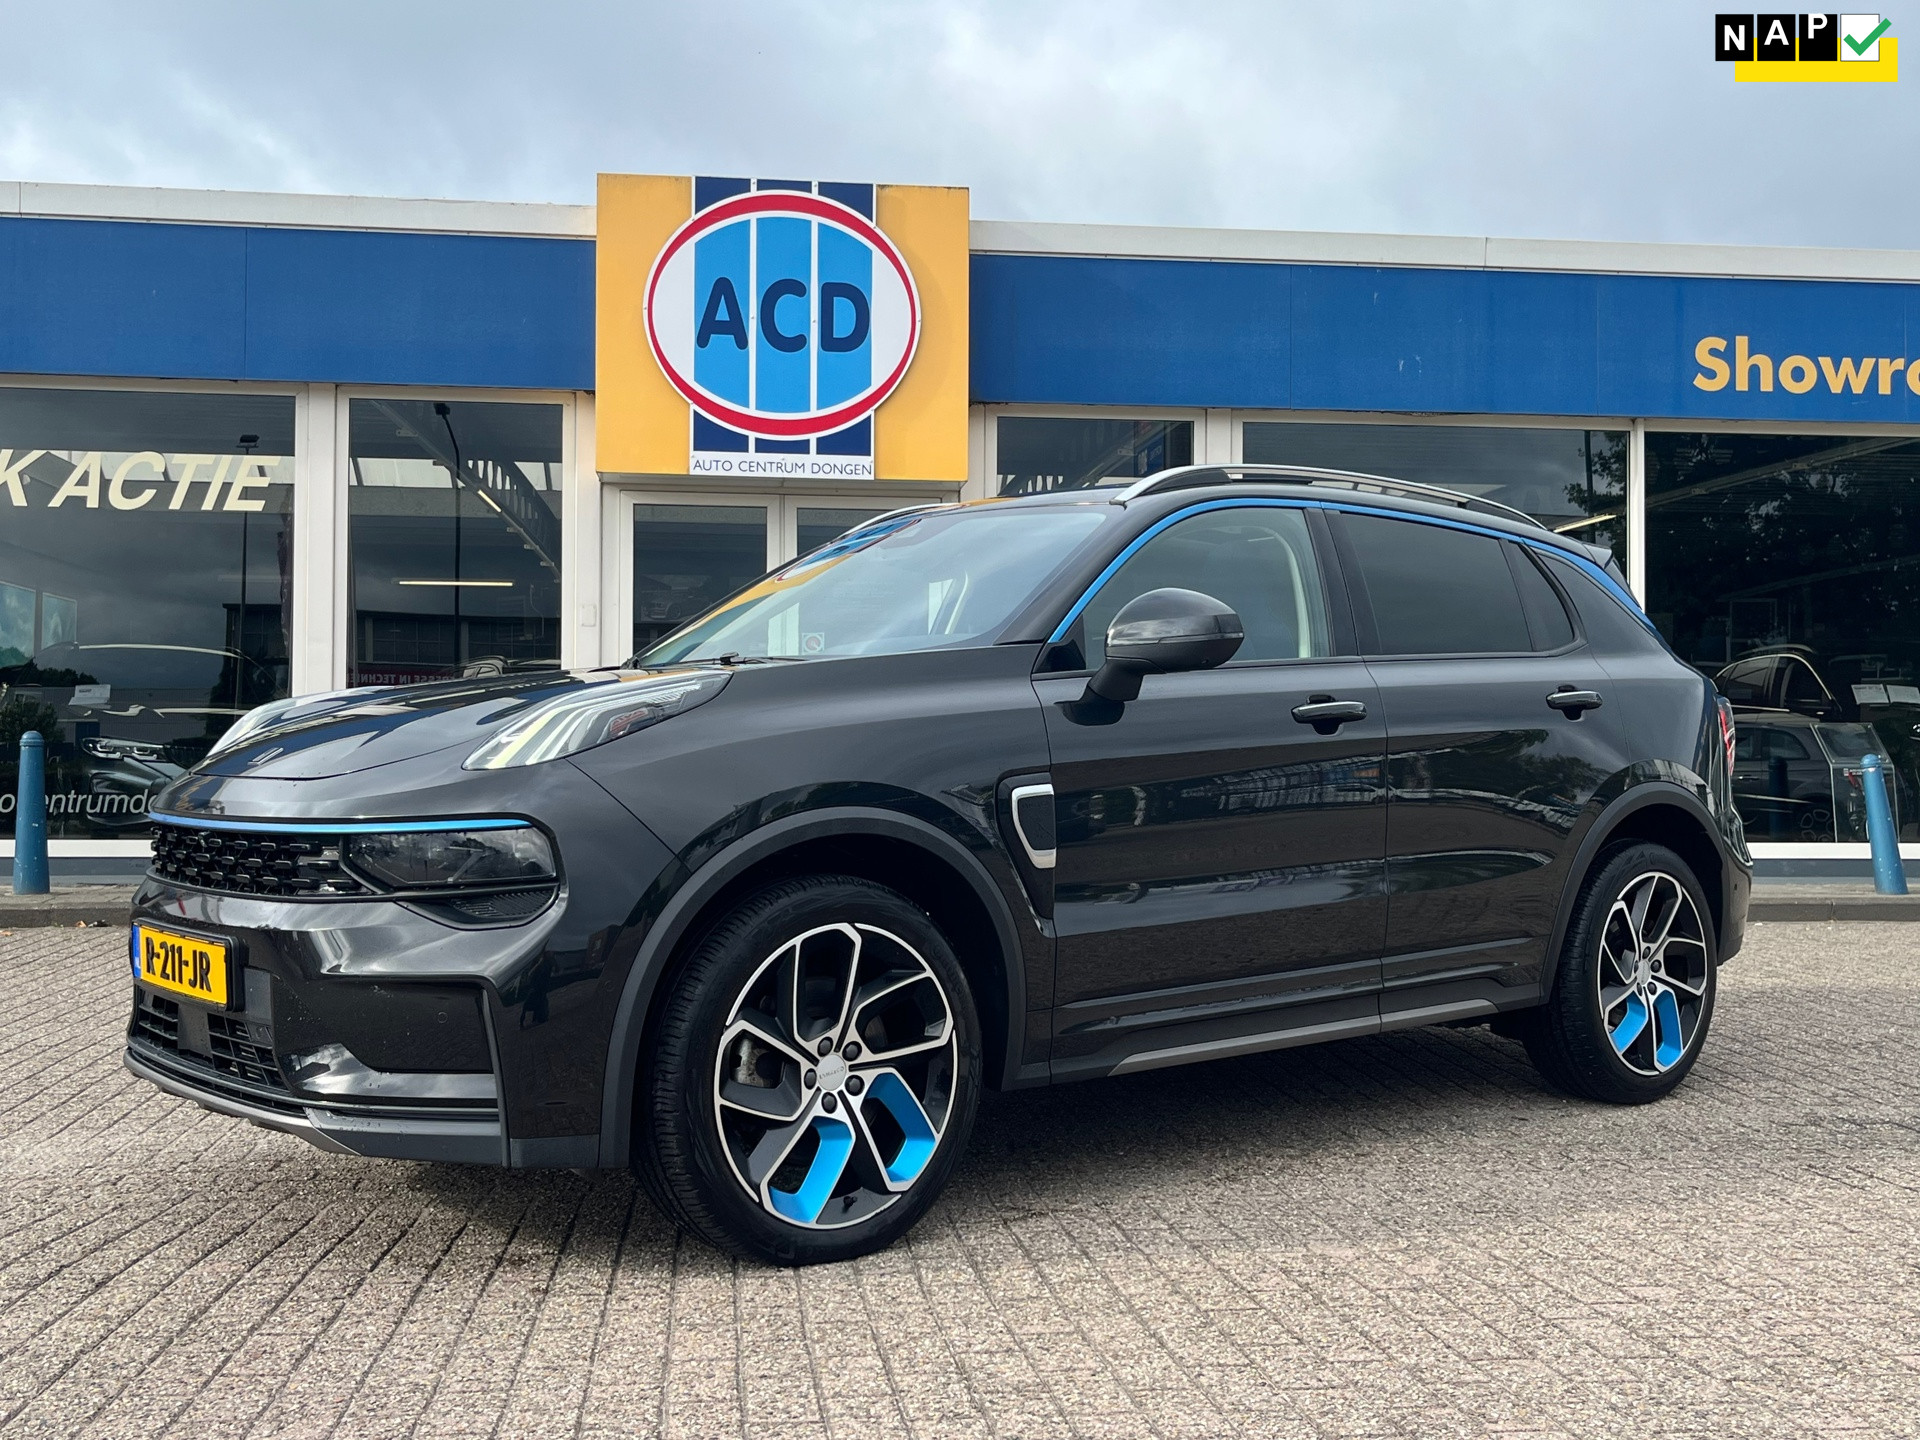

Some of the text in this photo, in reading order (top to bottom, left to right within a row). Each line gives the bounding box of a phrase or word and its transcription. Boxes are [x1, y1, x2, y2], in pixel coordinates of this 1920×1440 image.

[696, 276, 871, 353] ACD
[48, 450, 281, 511] ACTIE
[693, 460, 872, 476] AUTO CENTRUM DONGEN
[145, 936, 212, 993] R-211-JR
